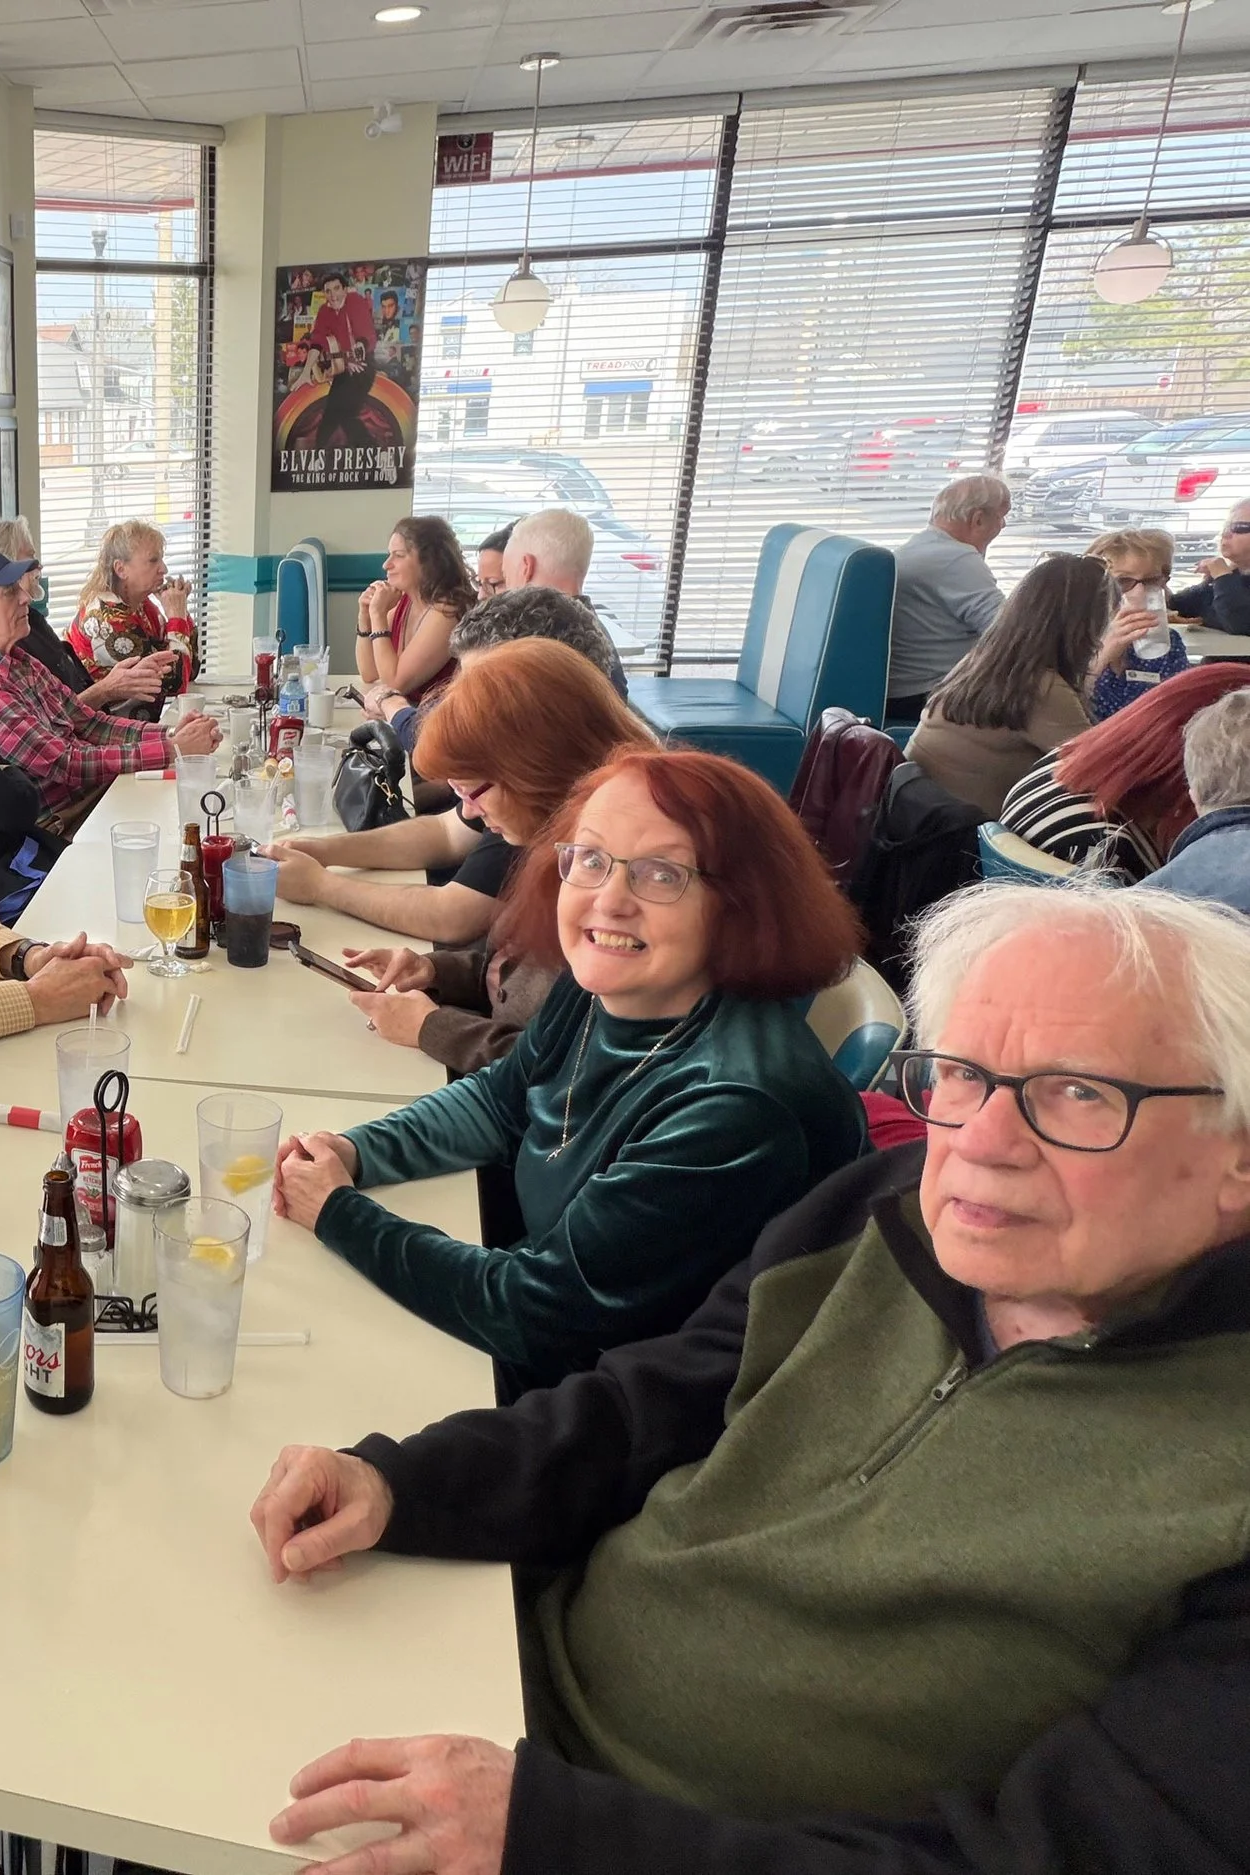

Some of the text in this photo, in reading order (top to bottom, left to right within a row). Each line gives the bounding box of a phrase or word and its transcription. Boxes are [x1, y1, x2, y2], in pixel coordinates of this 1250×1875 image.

[280, 446, 407, 472] ELVIS PRESLEY
[292, 474, 304, 483] THE
[306, 472, 325, 484] KING
[328, 473, 337, 482] OF
[339, 471, 359, 483] ROCK
[24, 1344, 61, 1370] ors
